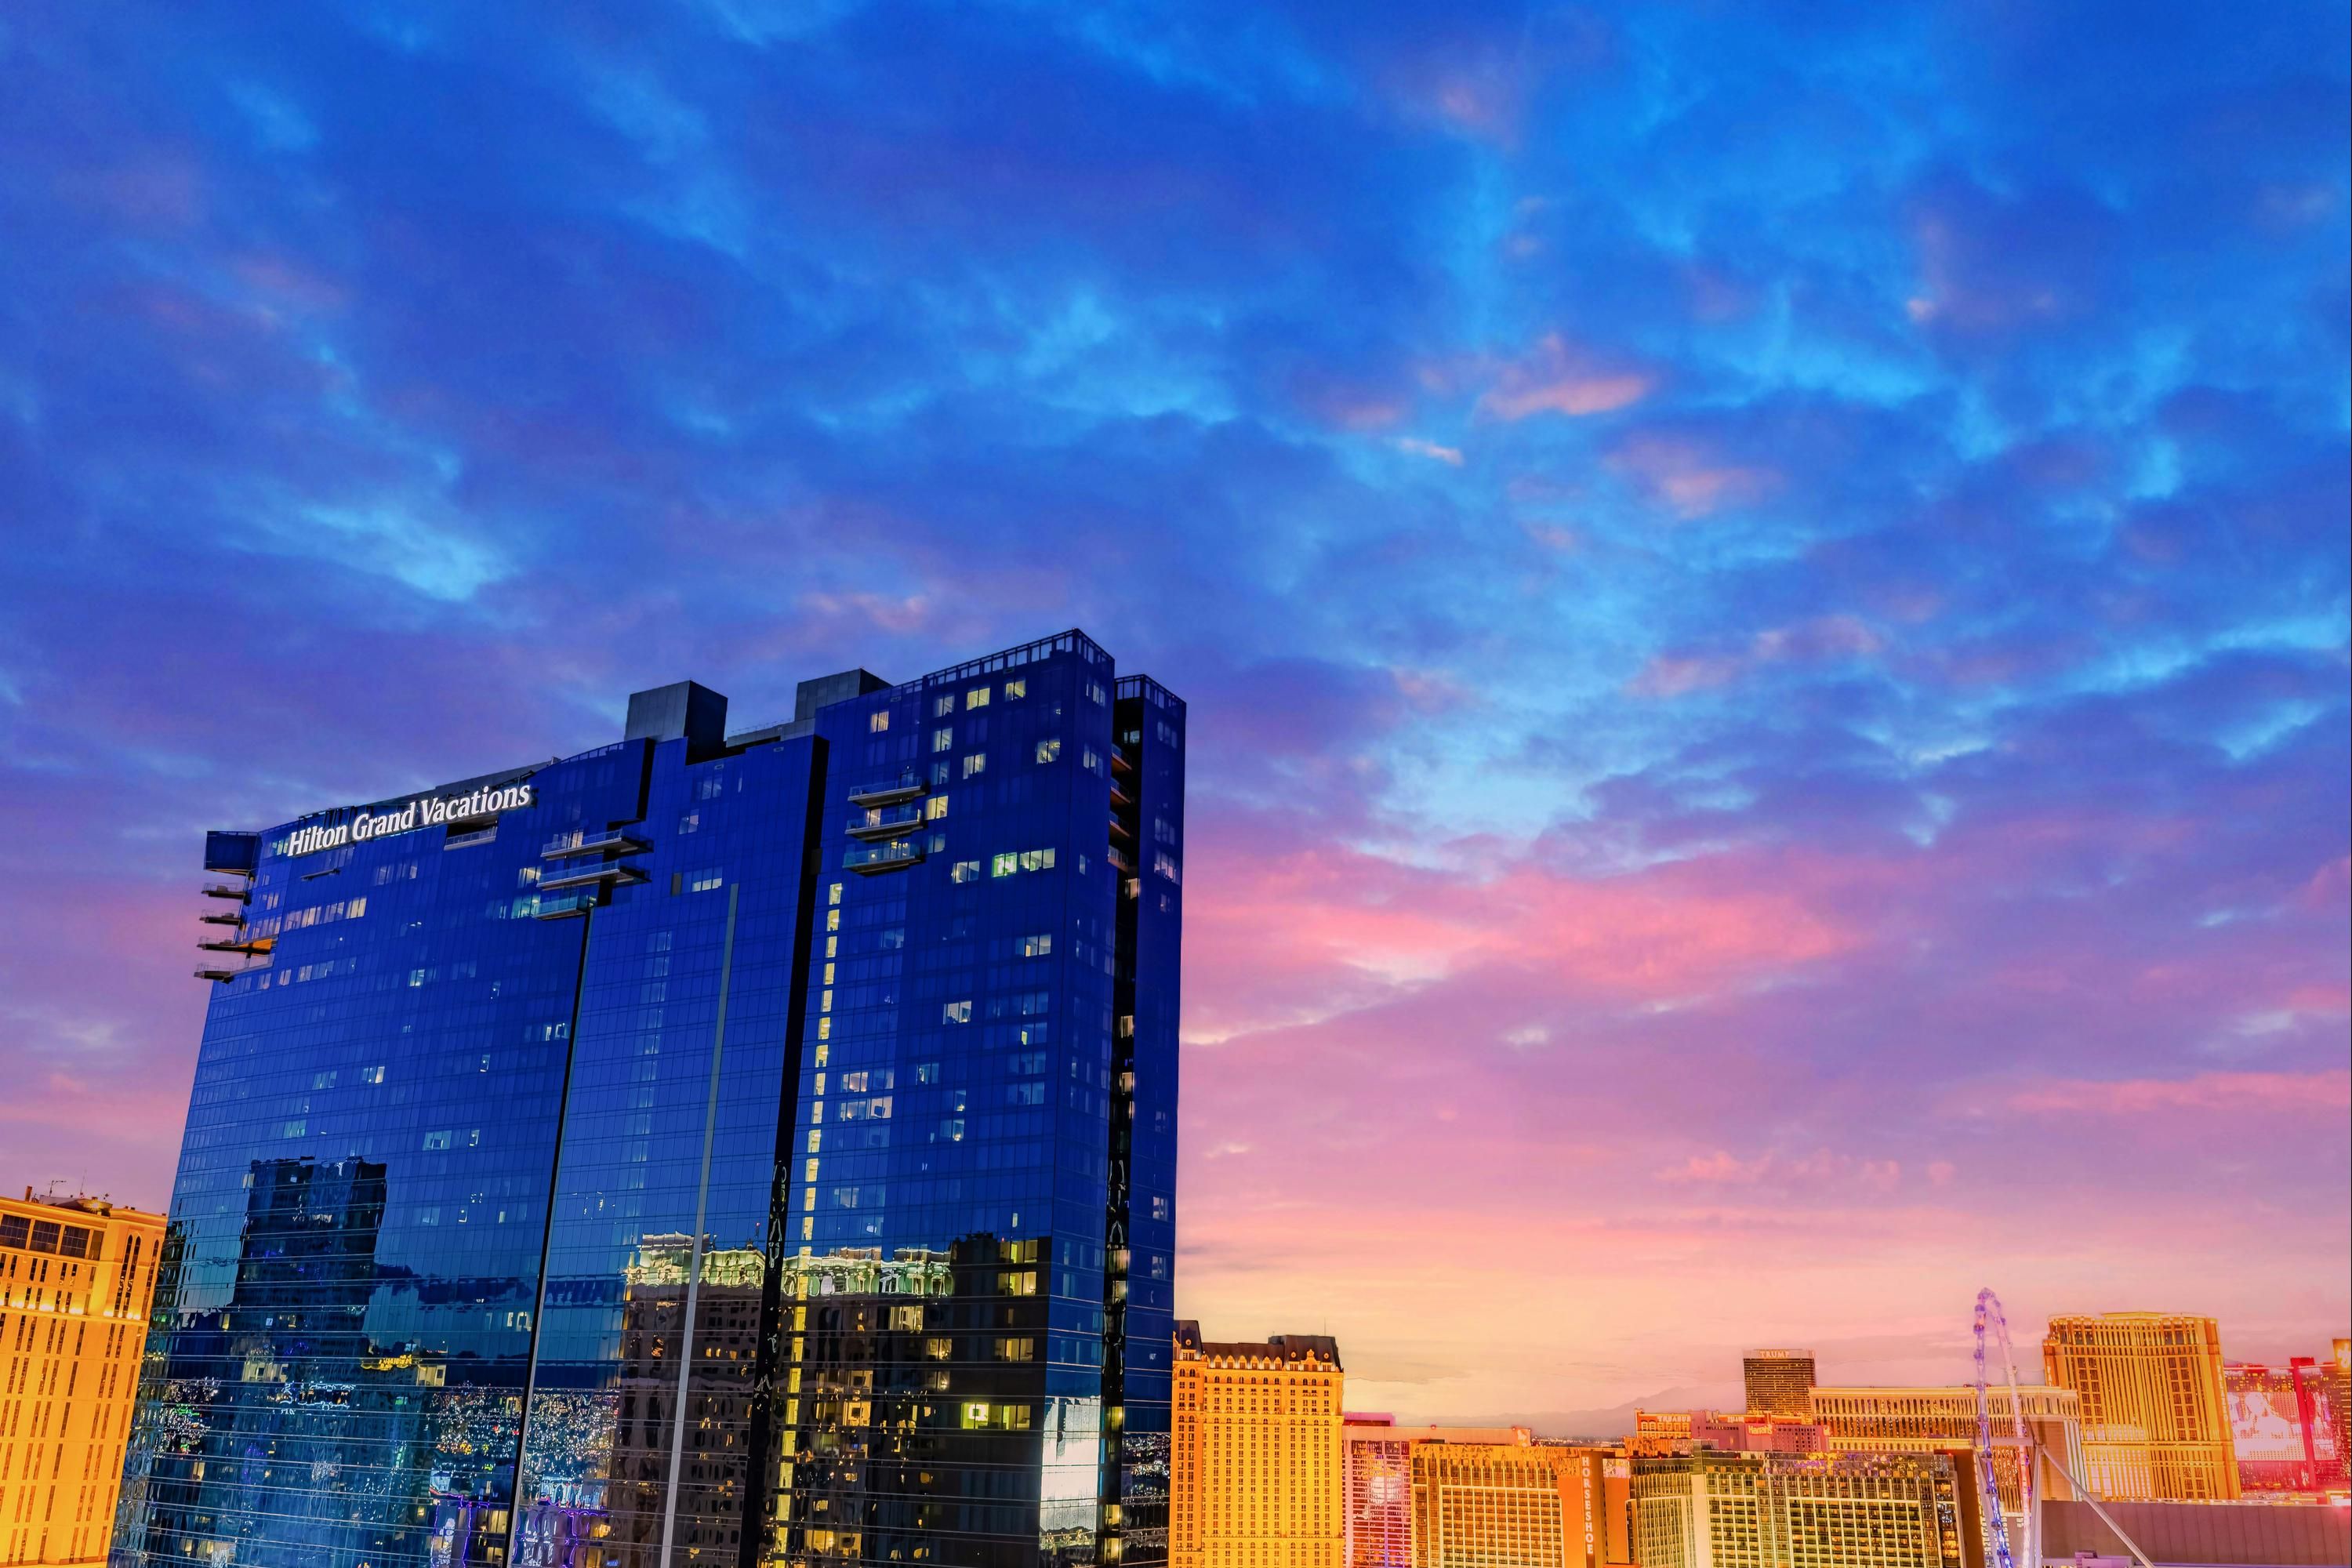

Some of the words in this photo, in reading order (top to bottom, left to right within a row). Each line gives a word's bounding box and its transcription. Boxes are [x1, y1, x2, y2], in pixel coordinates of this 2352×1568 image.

[287, 825, 347, 856] Hilton
[352, 801, 416, 840] Grand
[421, 785, 531, 825] Vacations
[1759, 1350, 1790, 1359] TRUMP
[1581, 1456, 1594, 1555] HORSESHOE
